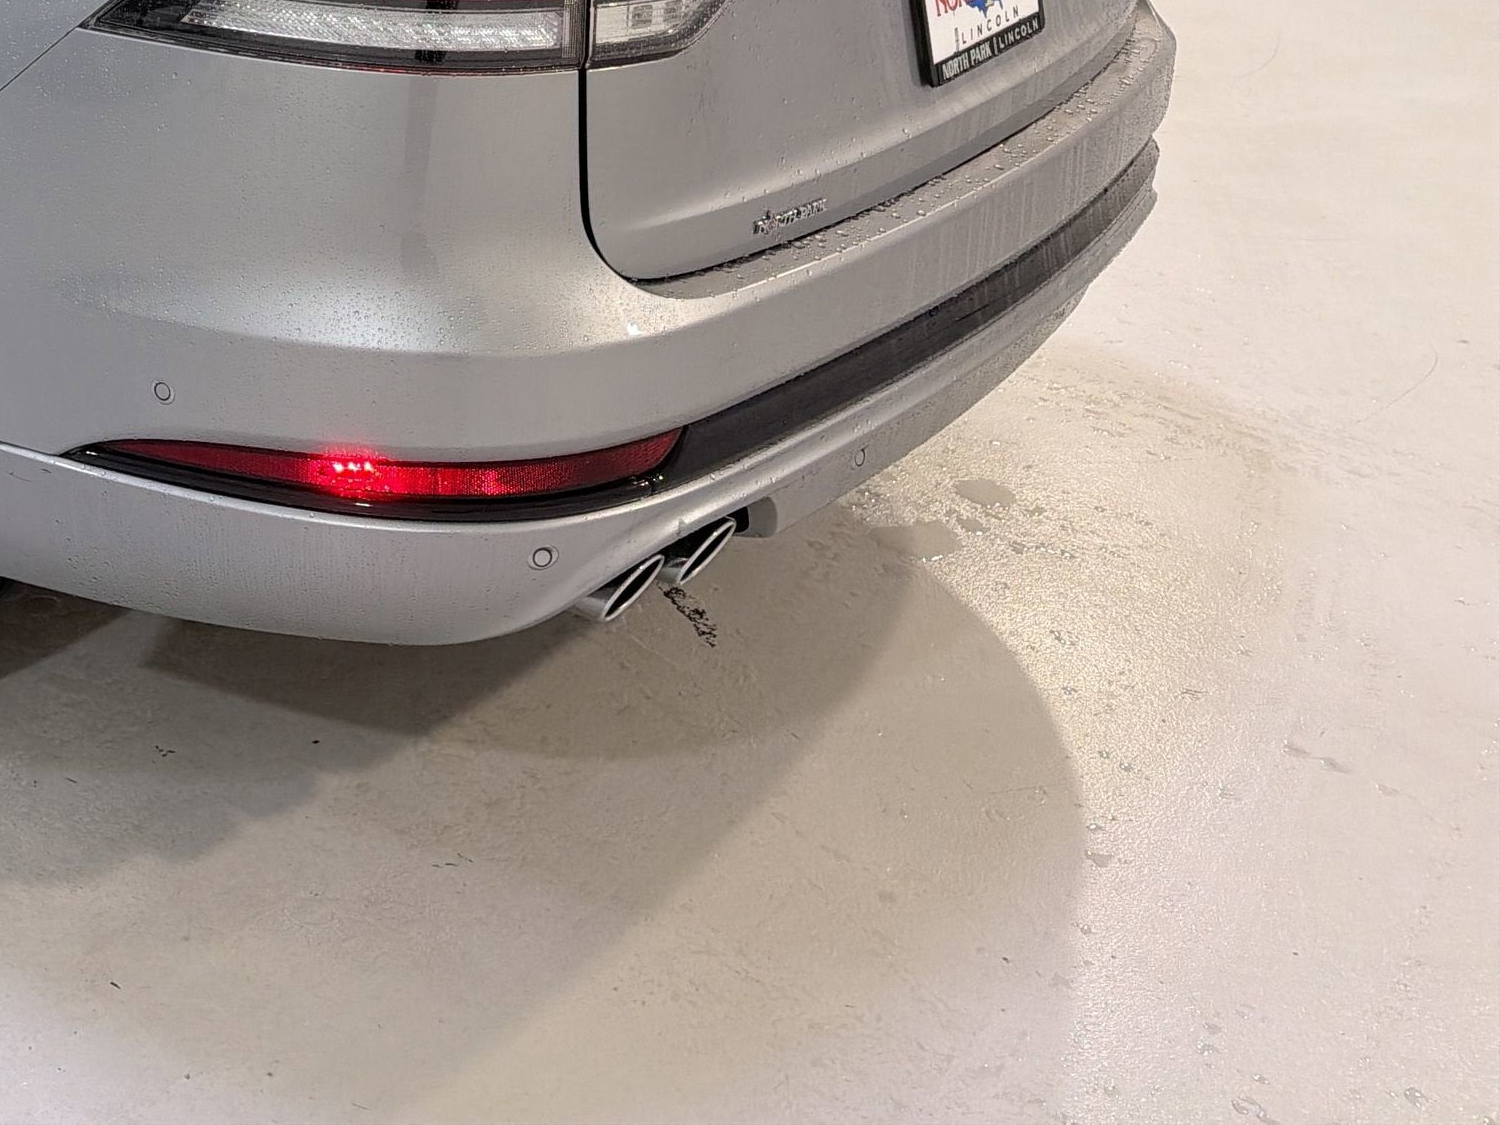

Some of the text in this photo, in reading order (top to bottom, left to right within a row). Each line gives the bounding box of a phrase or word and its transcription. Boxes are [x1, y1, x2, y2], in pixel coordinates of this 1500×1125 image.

[942, 17, 1039, 80] NORTH PARK LINCOLN
[962, 4, 1019, 45] LINCOLN
